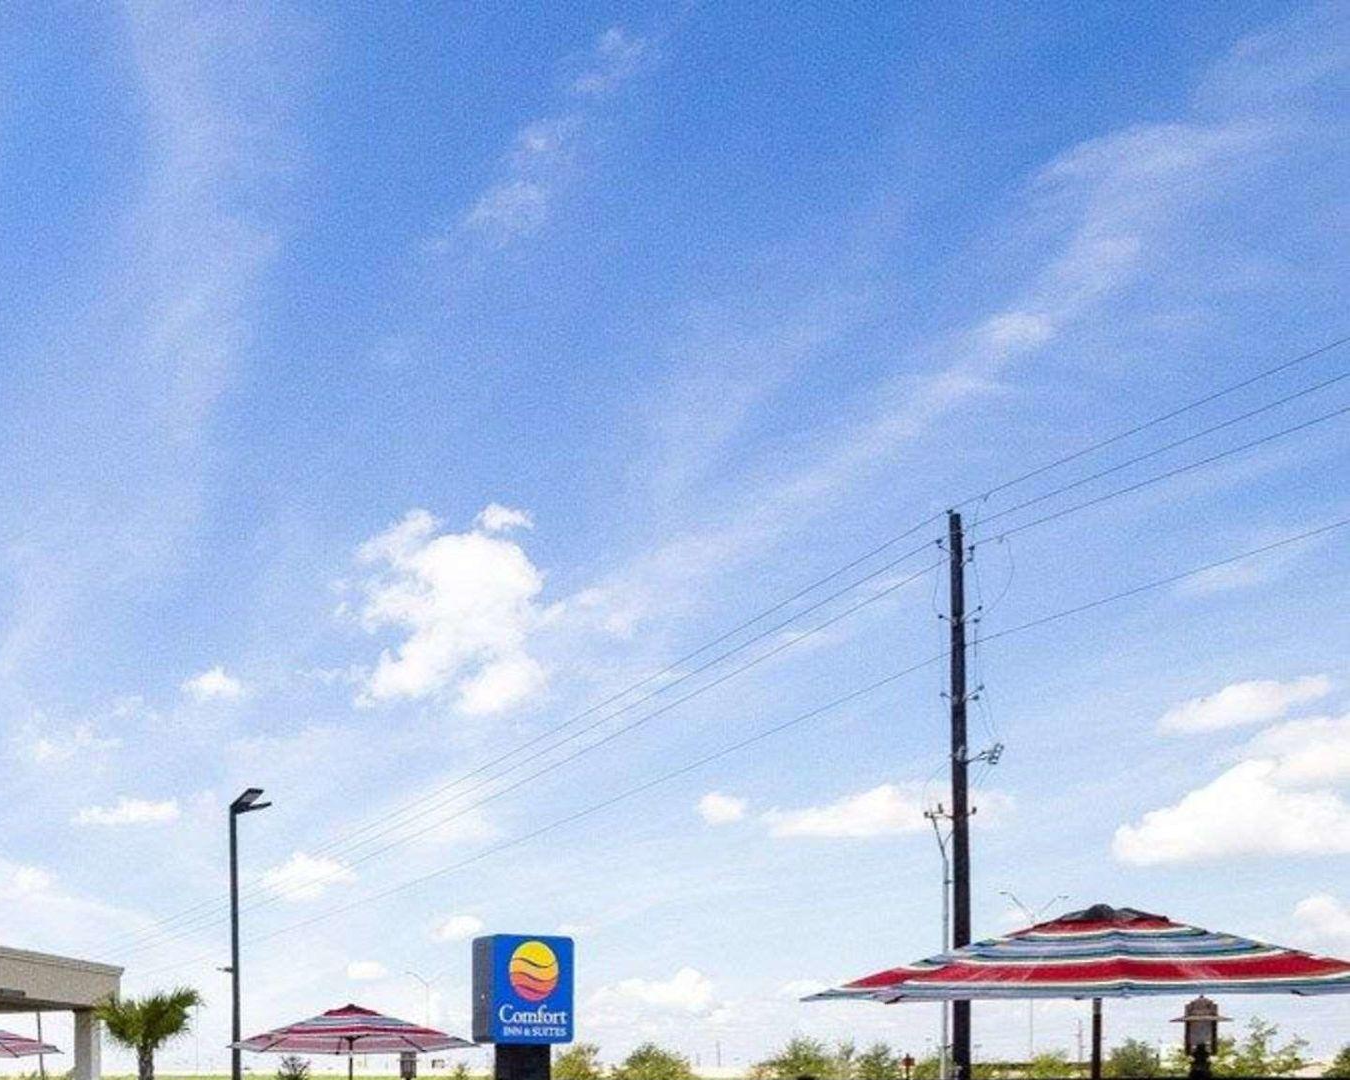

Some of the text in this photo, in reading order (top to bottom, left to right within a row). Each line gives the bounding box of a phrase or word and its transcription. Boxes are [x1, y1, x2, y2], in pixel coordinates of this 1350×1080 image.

[499, 1004, 568, 1025] Comfort
[503, 1025, 523, 1037] INN
[532, 1025, 568, 1037] SUITES
